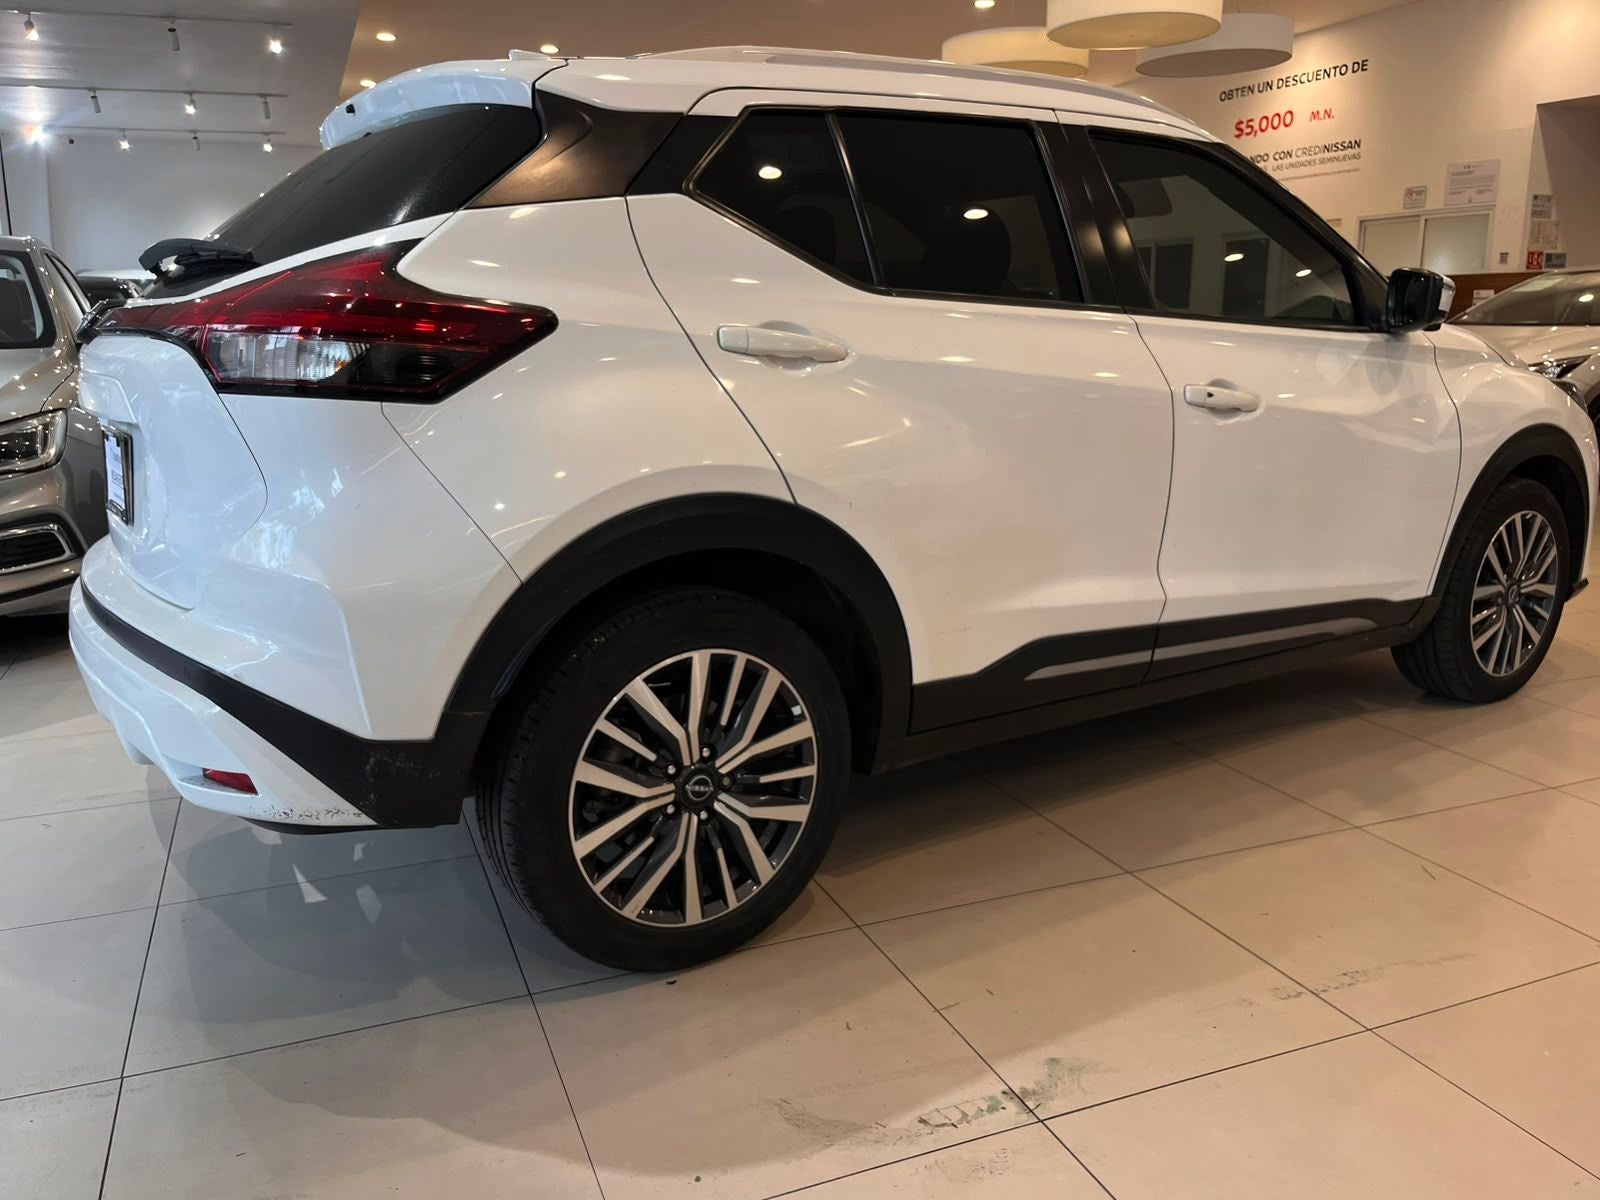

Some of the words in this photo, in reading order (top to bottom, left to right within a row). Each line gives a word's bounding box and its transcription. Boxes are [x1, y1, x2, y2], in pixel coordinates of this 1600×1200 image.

[1219, 84, 1255, 102] OBTEN
[1257, 80, 1273, 93] UN
[1276, 64, 1348, 90] DESCUENTO
[1351, 59, 1369, 74] DE
[1234, 110, 1294, 138] $5,000
[1309, 108, 1335, 122] M.N.
[1273, 149, 1293, 161] CON
[1285, 158, 1317, 170] UNIDADES
